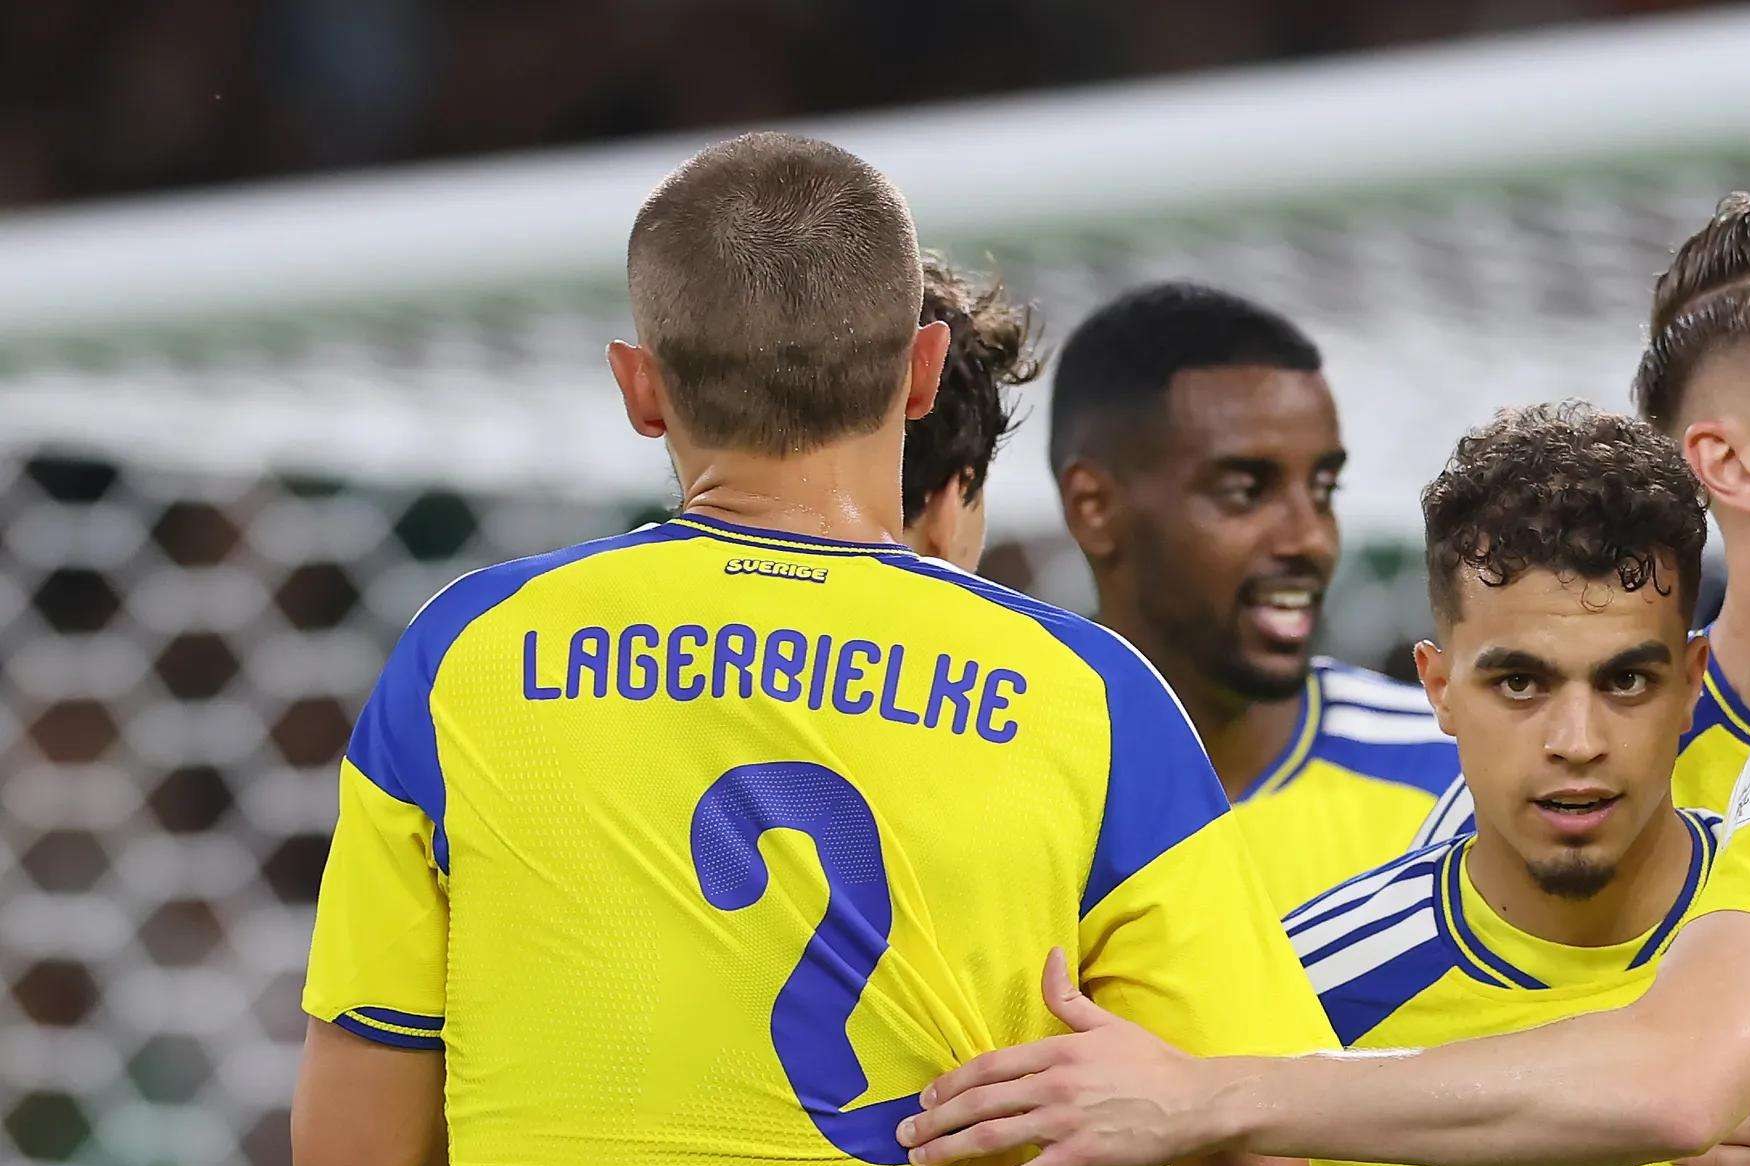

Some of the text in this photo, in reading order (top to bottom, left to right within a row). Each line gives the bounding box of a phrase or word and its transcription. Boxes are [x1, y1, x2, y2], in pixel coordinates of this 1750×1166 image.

[724, 557, 829, 583] SVERIGE
[522, 623, 1028, 744] LAGERBIELKE
[689, 759, 925, 1166] 2
